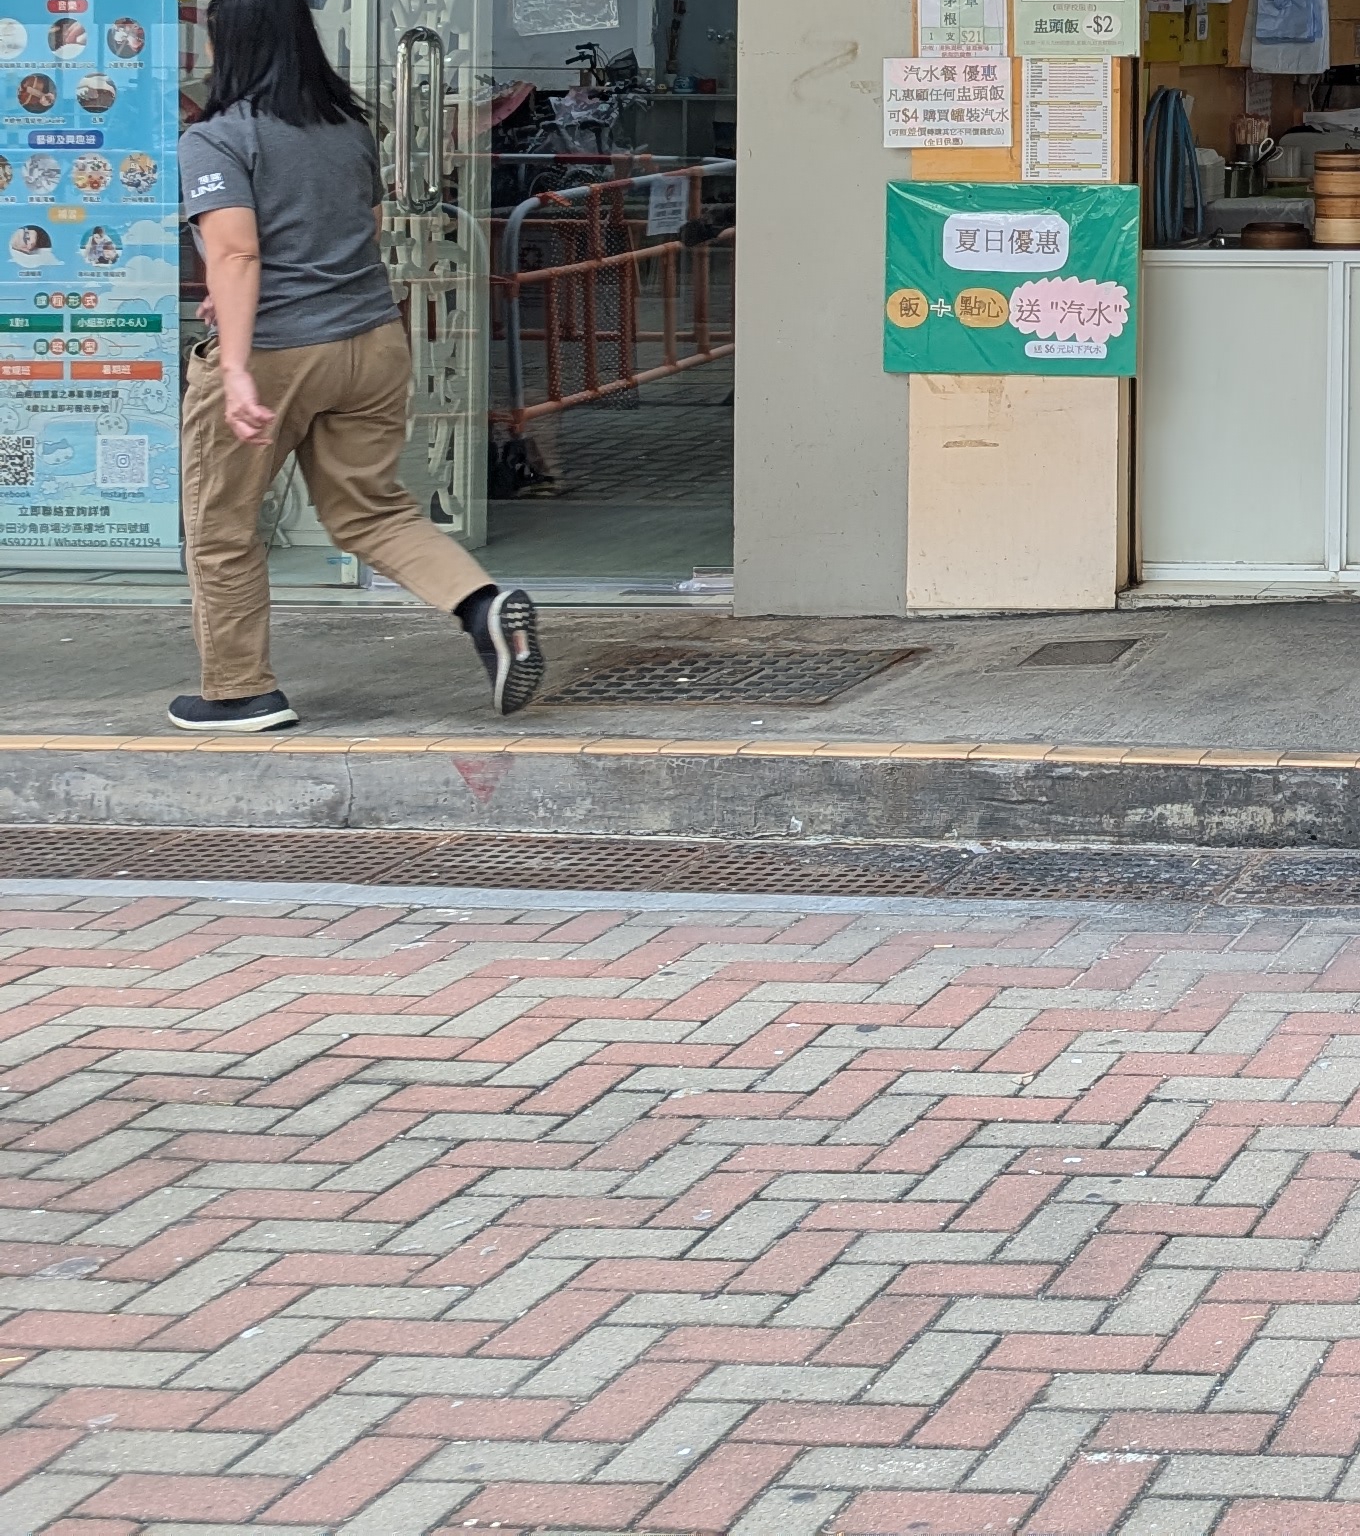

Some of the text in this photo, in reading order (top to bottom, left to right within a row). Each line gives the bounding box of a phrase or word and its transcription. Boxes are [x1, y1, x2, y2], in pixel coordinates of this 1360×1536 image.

[1033, 14, 1114, 34] 盅頭飯 -$2
[961, 30, 982, 44] $21
[903, 64, 998, 82] 汽水餐 優惠
[886, 85, 1005, 102] 凡惠顧任何盅頭飯
[922, 107, 1010, 123] 購買罐裝汽水
[954, 228, 1061, 255] 夏日優惠
[899, 296, 921, 318] 飯
[959, 295, 1004, 319] 點心
[1015, 297, 1041, 323] 送
[1044, 344, 1055, 354] $6
[1056, 344, 1102, 355] 元以下汽水
[100, 490, 145, 500] Instagram
[54, 537, 108, 549] Whatsapp
[109, 536, 161, 548] 65742194
